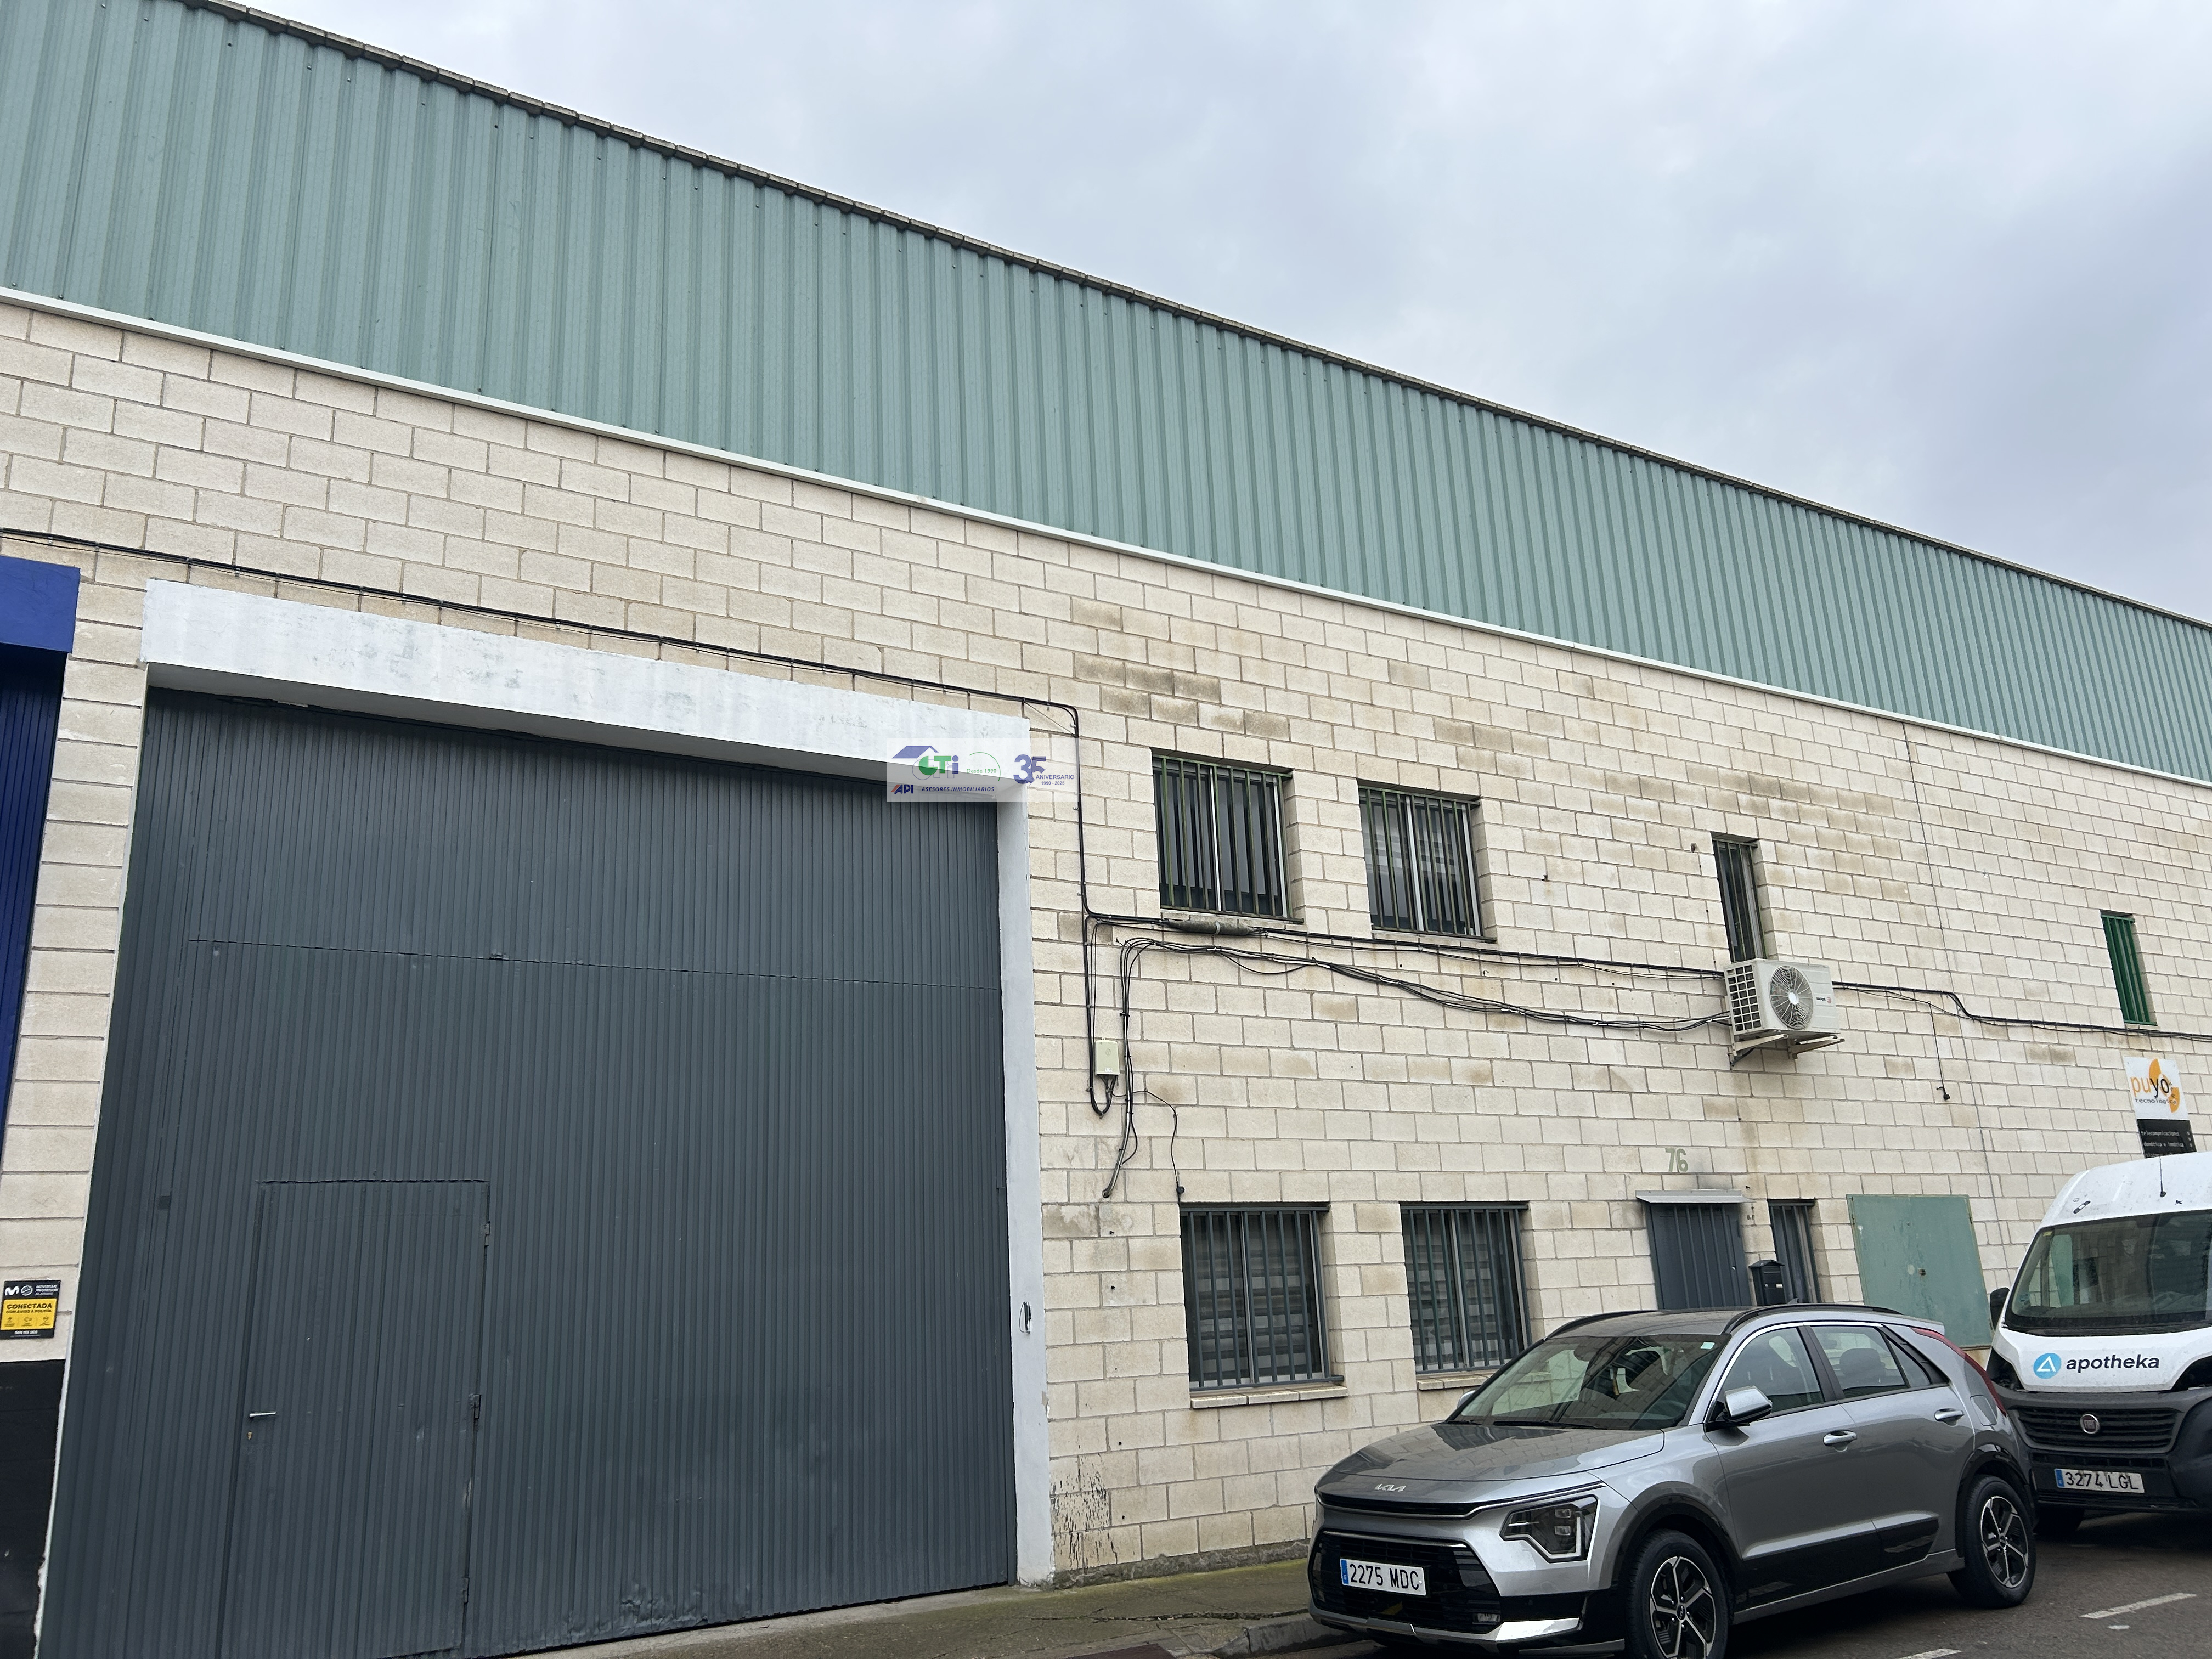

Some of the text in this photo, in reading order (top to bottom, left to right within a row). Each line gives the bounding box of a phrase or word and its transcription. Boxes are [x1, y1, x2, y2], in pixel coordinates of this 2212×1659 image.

[2130, 1077, 2169, 1098] puyo
[1664, 1148, 1689, 1172] 76
[2066, 1353, 2160, 1374] apotheka
[2065, 1472, 2103, 1488] 3274
[2107, 1474, 2139, 1490] LGL
[1350, 1564, 1384, 1586] 2275
[1389, 1567, 1420, 1590] MDC
